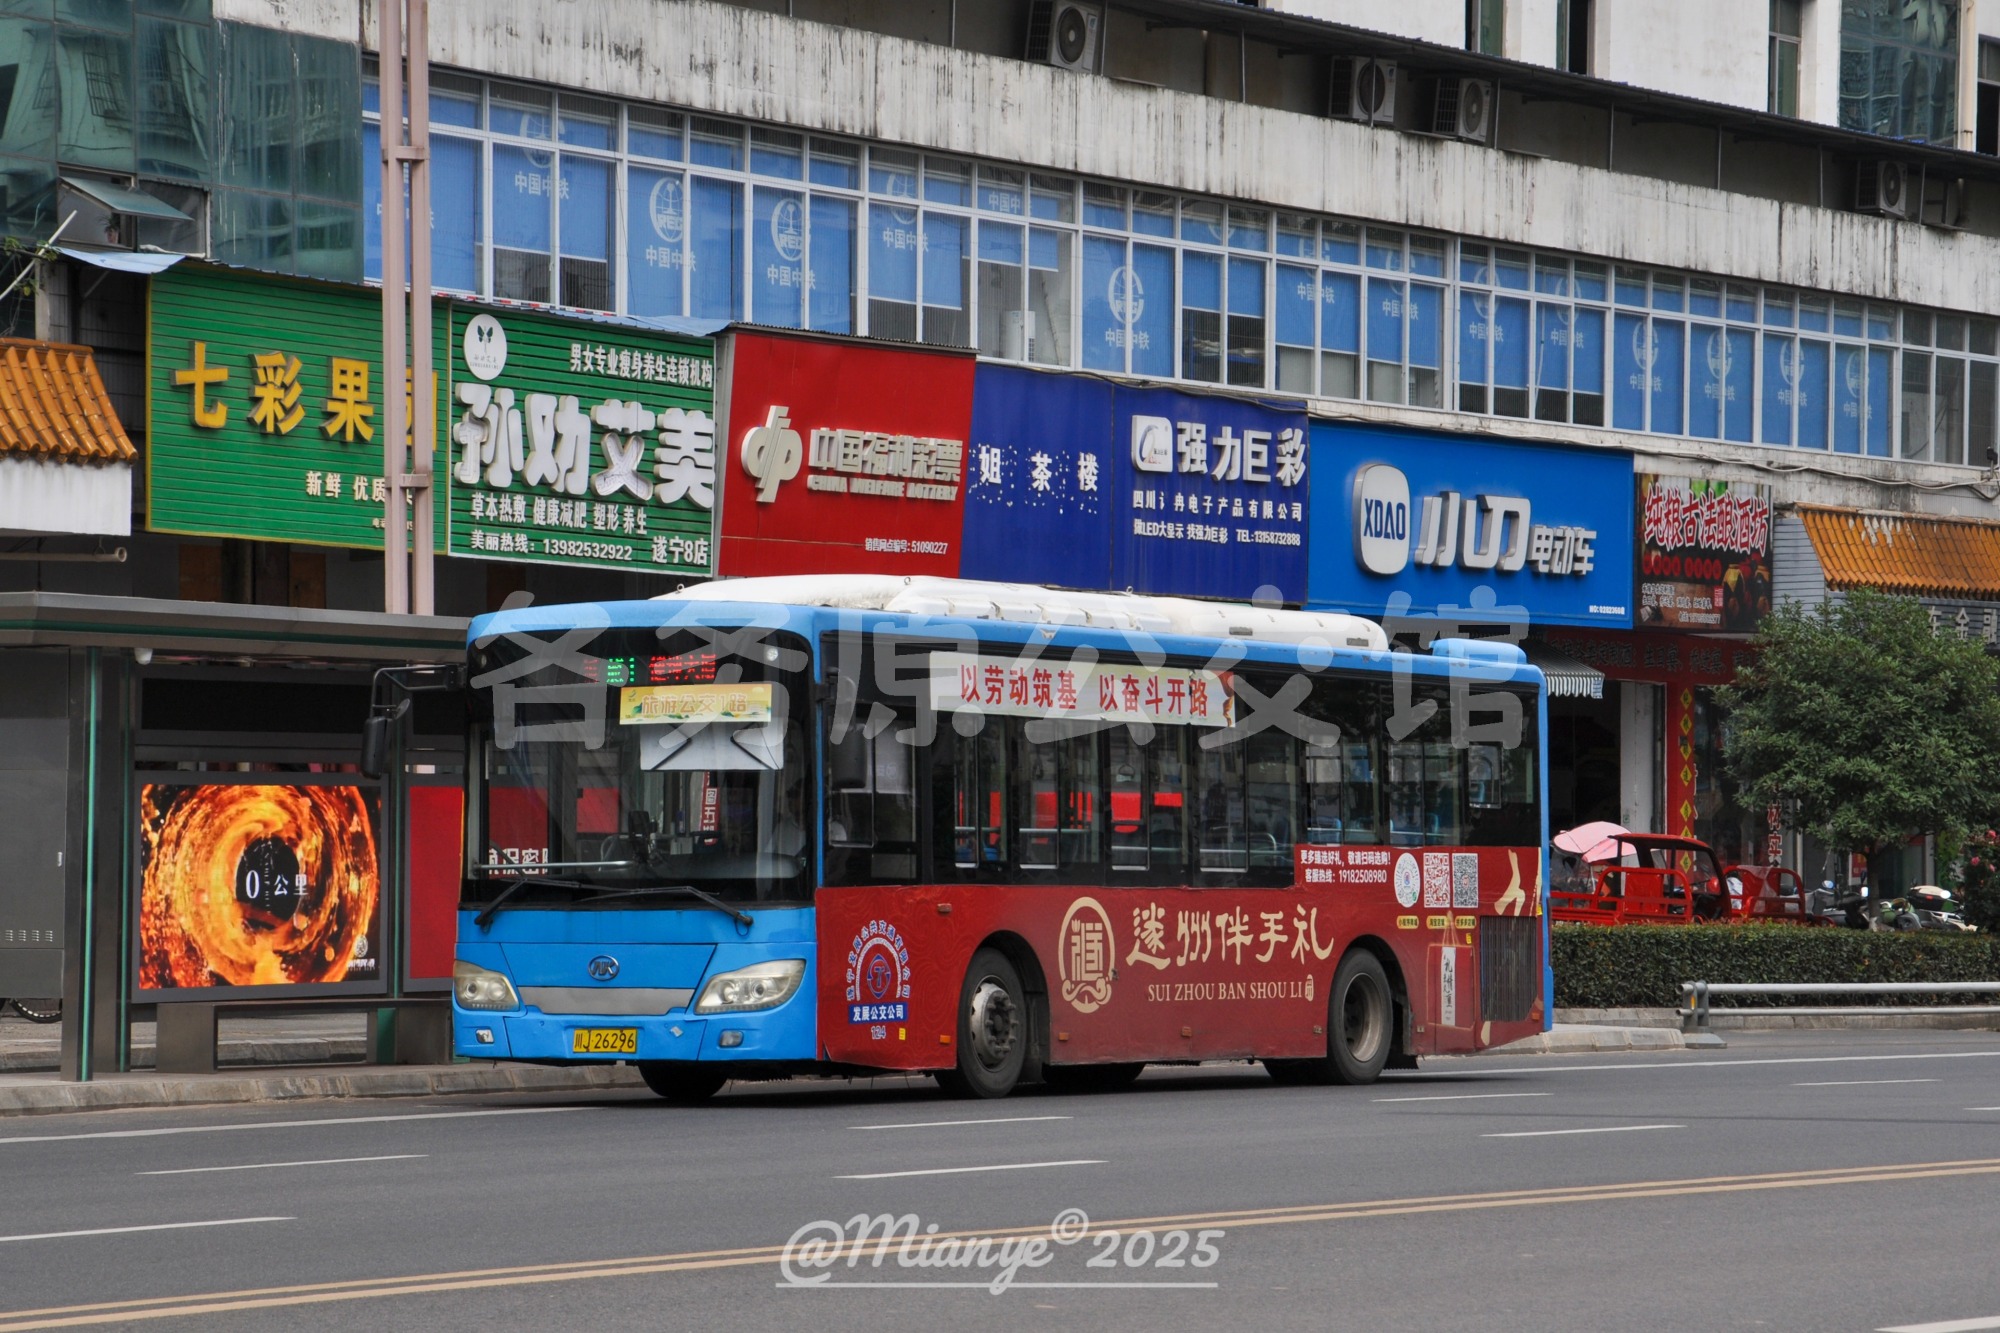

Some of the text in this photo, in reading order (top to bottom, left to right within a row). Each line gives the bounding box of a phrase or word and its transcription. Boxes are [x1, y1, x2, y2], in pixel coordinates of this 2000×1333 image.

[988, 191, 1032, 216] 中国中
[1382, 298, 1419, 321] 中国铁
[1551, 328, 1585, 349] 中国铁
[570, 343, 713, 388] 男女专业瘦身养生连锁机构
[809, 427, 963, 482] 中国福利彩票
[1176, 421, 1306, 487] 强力巨彩
[305, 471, 341, 498] 新鲜
[471, 493, 648, 535] 草本热敷 健康减肥 塑形 养生
[1363, 498, 1406, 541] XDAO
[1644, 482, 1769, 557] 纯粮古法酿酒坊
[651, 536, 709, 565] 遂宁8店
[1528, 524, 1597, 576] 电动车
[642, 692, 747, 715] 旅游公交1路
[960, 663, 1209, 718] 以劳动筑基 以奋斗开路
[273, 874, 308, 896] 公里
[1125, 902, 1334, 970] 遂州伴手礼
[1148, 983, 1171, 1001] SUI
[1175, 983, 1214, 1001] ZHOU
[1218, 982, 1247, 1000] BAN
[1250, 981, 1287, 1000] SHOU
[1290, 981, 1303, 999] LI
[853, 1004, 904, 1022] 发展公交公司
[871, 1025, 886, 1040] 124
